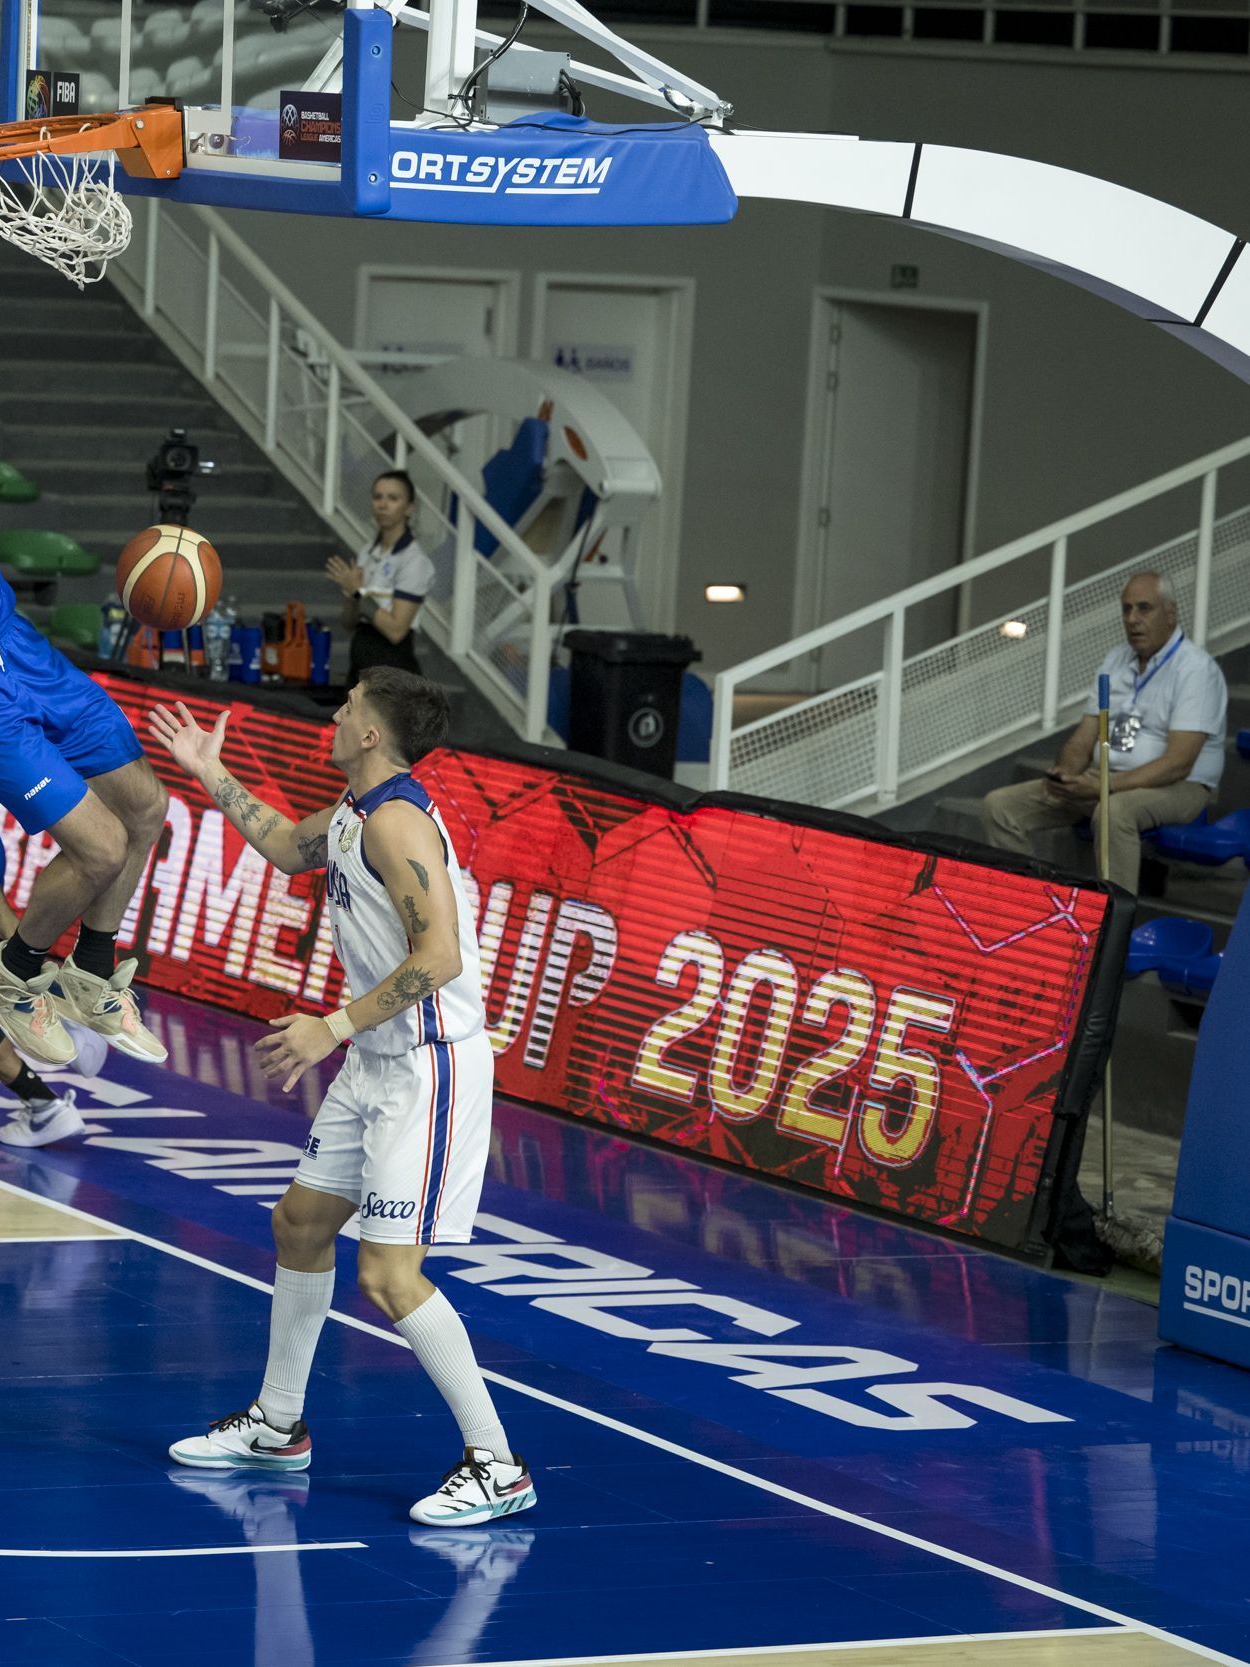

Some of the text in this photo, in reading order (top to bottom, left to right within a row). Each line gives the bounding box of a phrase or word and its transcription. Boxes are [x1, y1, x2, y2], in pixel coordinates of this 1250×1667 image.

[56, 81, 76, 103] FIBA
[301, 111, 330, 121] BASKETBALL
[301, 121, 341, 133] CHAMPIONS
[390, 151, 613, 188] ORTSYSTEM
[631, 929, 958, 1168] 2025
[361, 1191, 416, 1219] Secco
